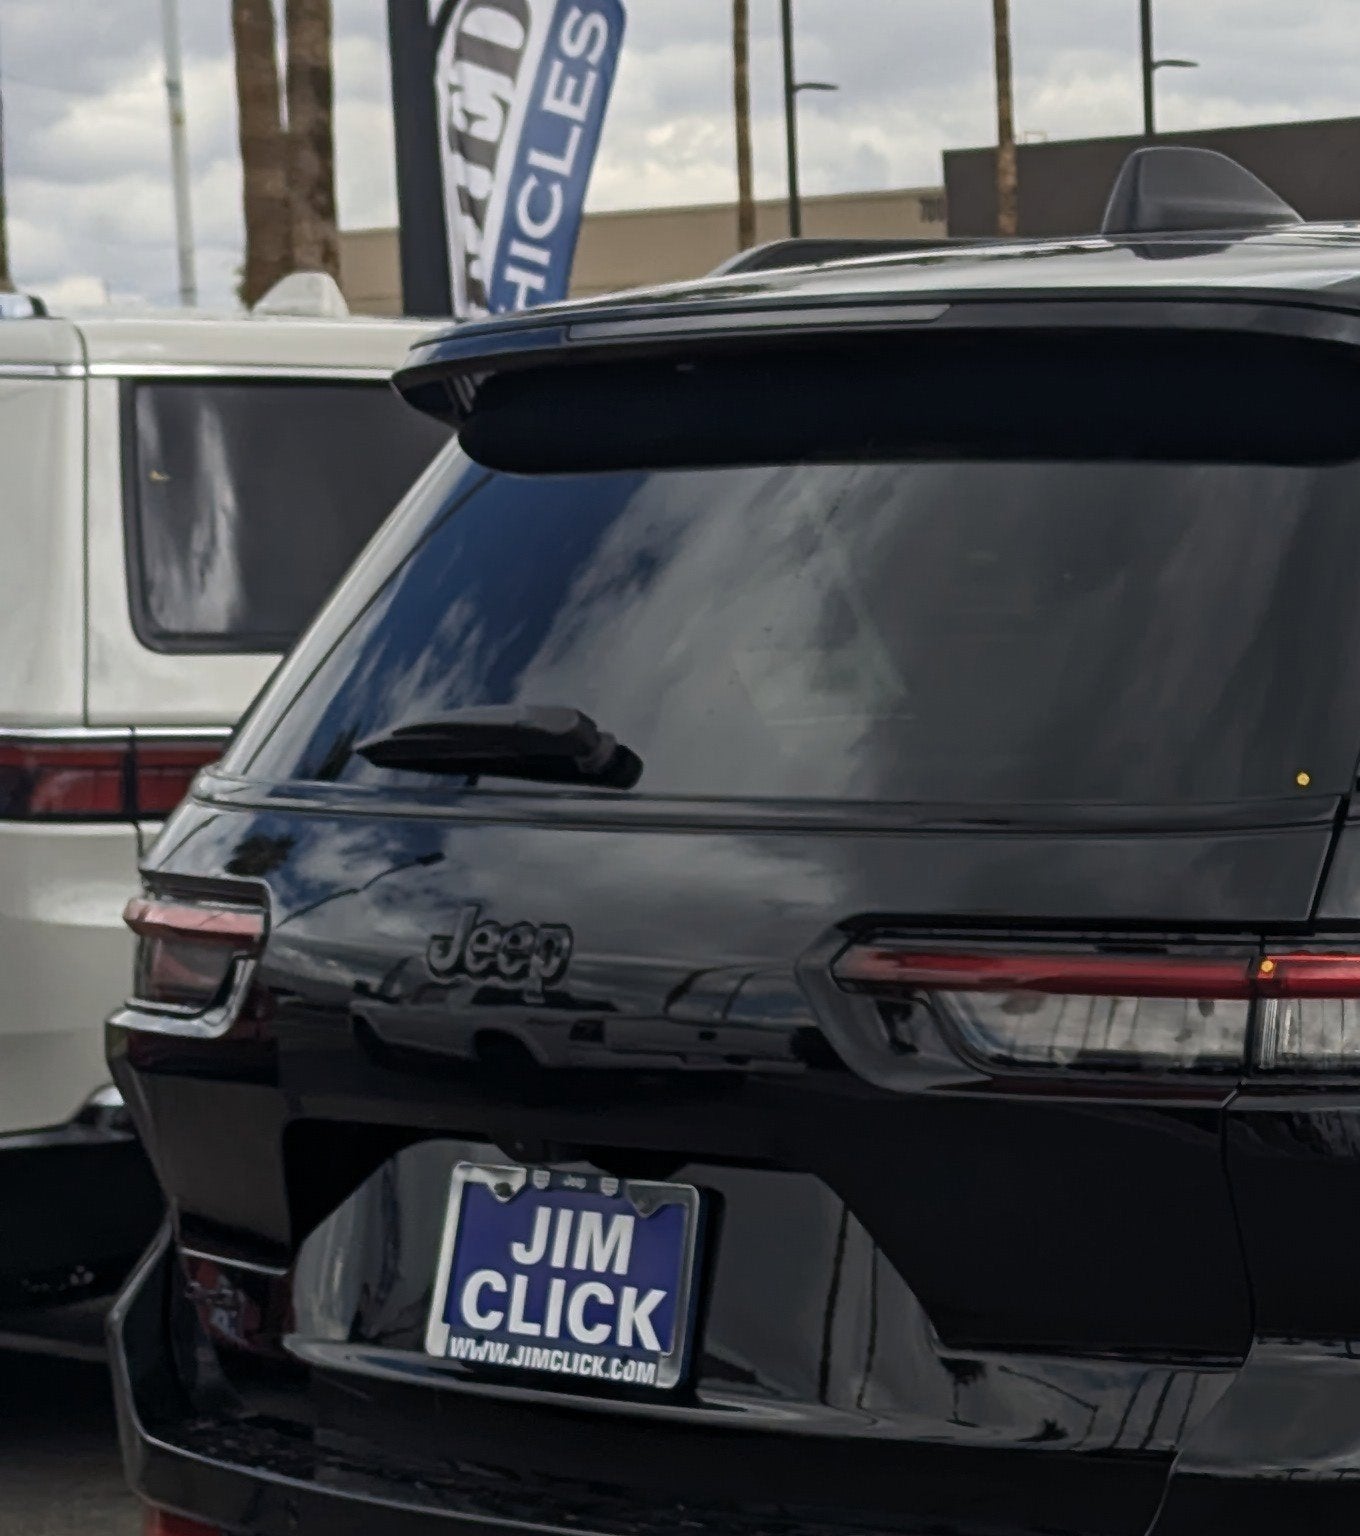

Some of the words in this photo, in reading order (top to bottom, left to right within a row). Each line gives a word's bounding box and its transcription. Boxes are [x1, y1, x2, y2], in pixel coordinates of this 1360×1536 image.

[499, 5, 608, 311] HICLES
[428, 902, 574, 1003] Jeep
[510, 1205, 635, 1276] JIM
[460, 1268, 668, 1352] CLICK
[450, 1336, 657, 1386] WWW.JIMCLICK.COM
